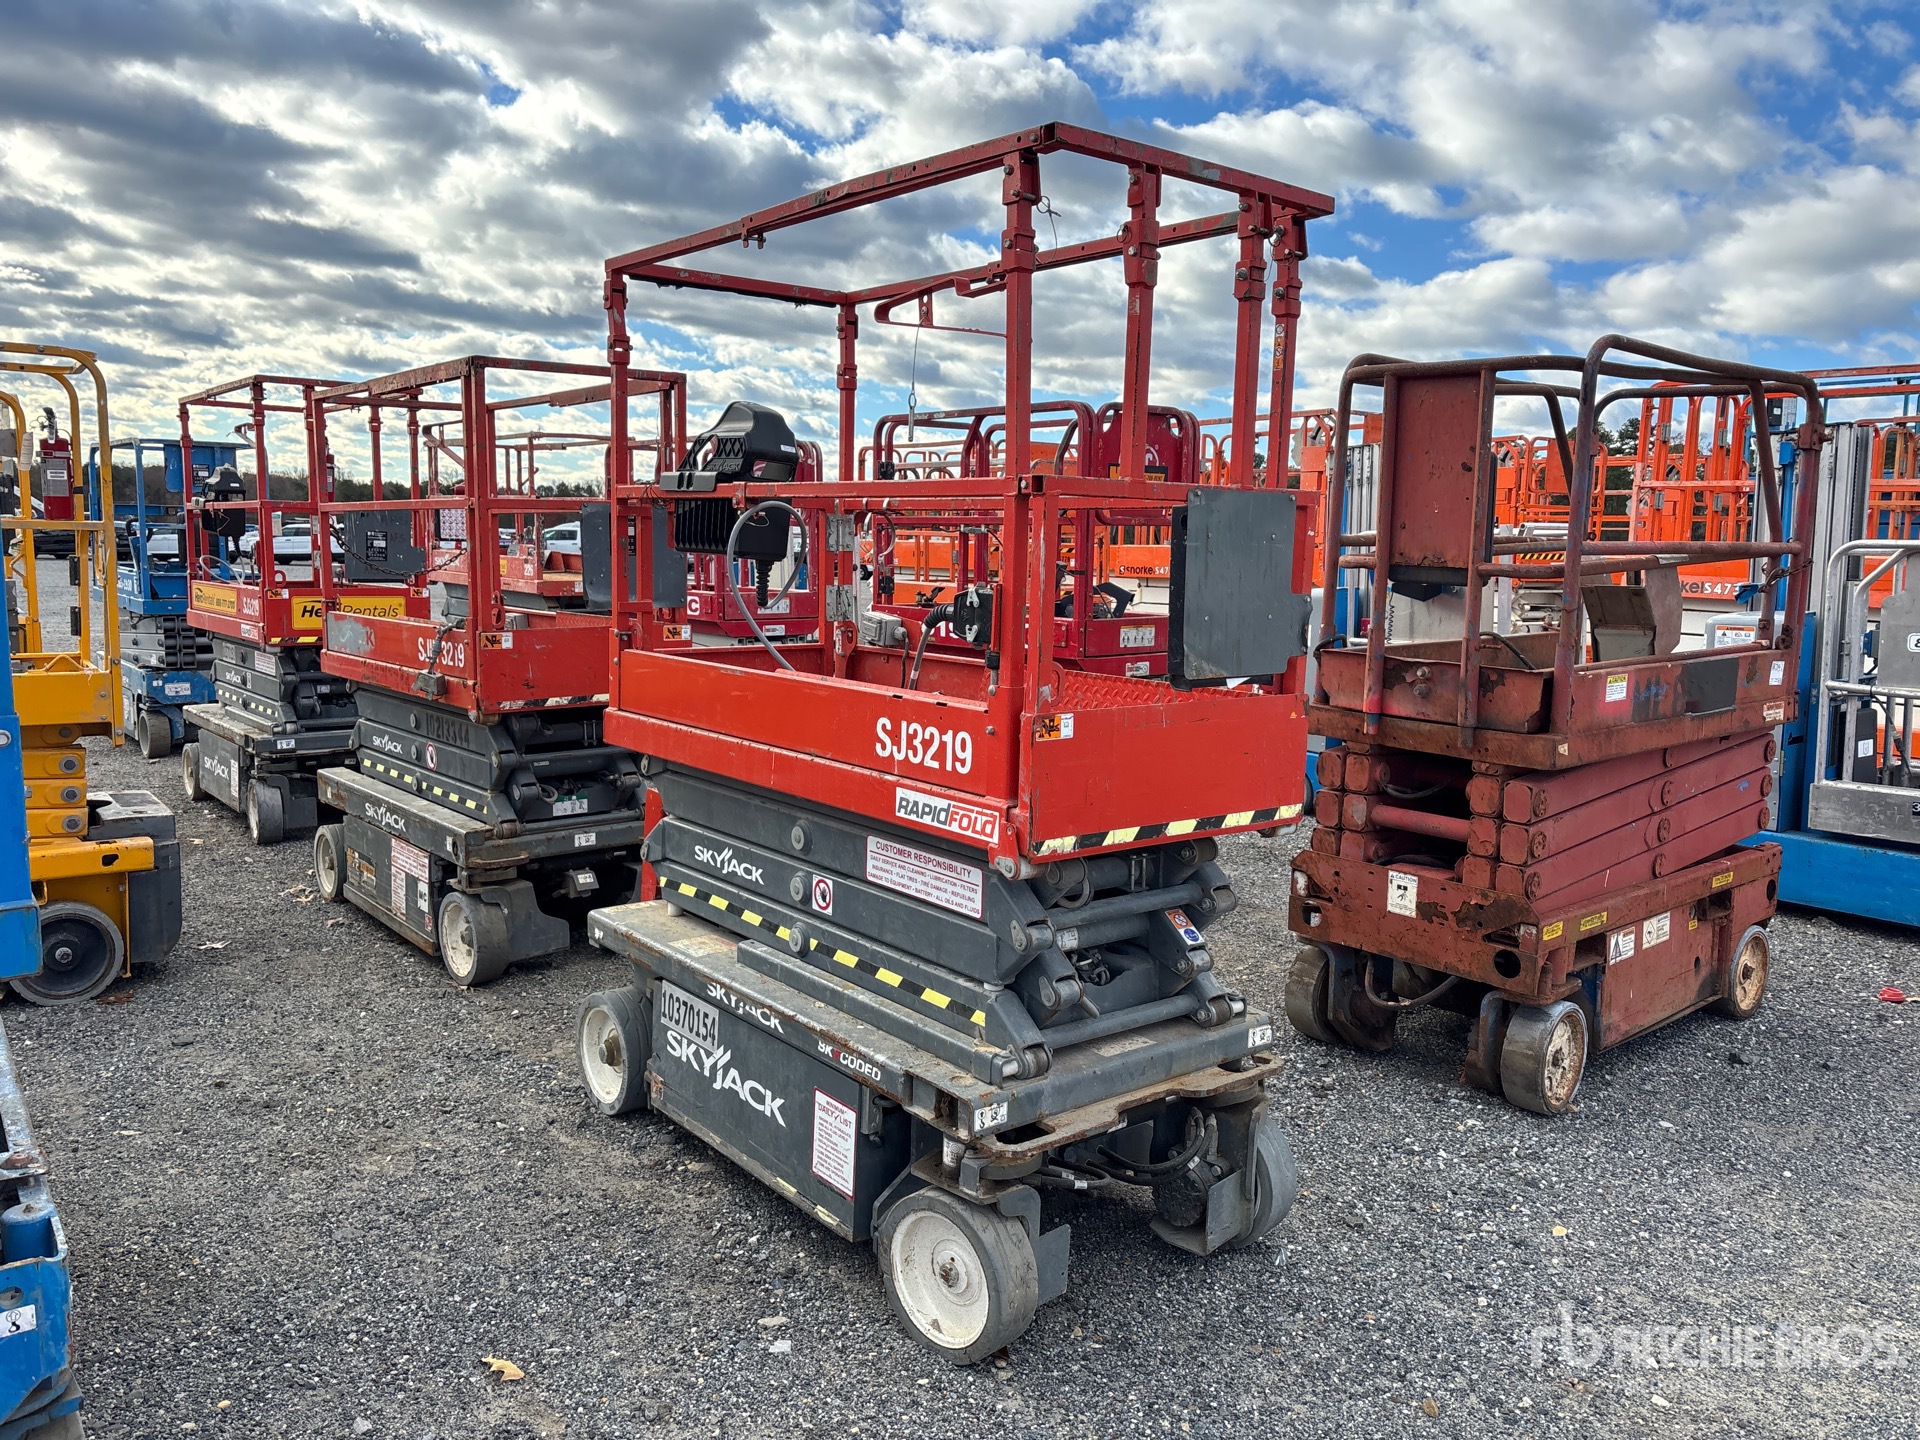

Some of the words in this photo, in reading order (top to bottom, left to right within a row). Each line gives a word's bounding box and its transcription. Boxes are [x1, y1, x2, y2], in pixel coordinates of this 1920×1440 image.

[372, 734, 403, 754] SKYJACK
[875, 716, 973, 775] SJ3219
[204, 755, 230, 780] SKYJACK
[364, 802, 406, 832] SKYJACK
[694, 844, 764, 885] SKYJACK
[876, 841, 912, 859] CUSTOMER
[914, 853, 972, 878] RESPONSIBILITY
[882, 857, 897, 868] SERVICE
[907, 866, 927, 877] CLEANING
[930, 872, 958, 887] LUBRICATION
[960, 884, 978, 894] FILTERS
[868, 872, 884, 881] DAMAGE
[890, 879, 912, 891] EQUIPMENT
[915, 886, 933, 898] BATTERY
[965, 905, 980, 915] FLUIDS
[872, 864, 893, 876] INSURANCE
[906, 875, 917, 884] TIRES
[930, 884, 948, 894] DAMAGE
[951, 891, 975, 903] REFUELING
[1395, 874, 1417, 883] CAUTION
[662, 990, 716, 1047] 10370154
[666, 1030, 786, 1128] SKYJACK
[818, 1102, 833, 1118] DAILY
[839, 1115, 851, 1129] LIST
